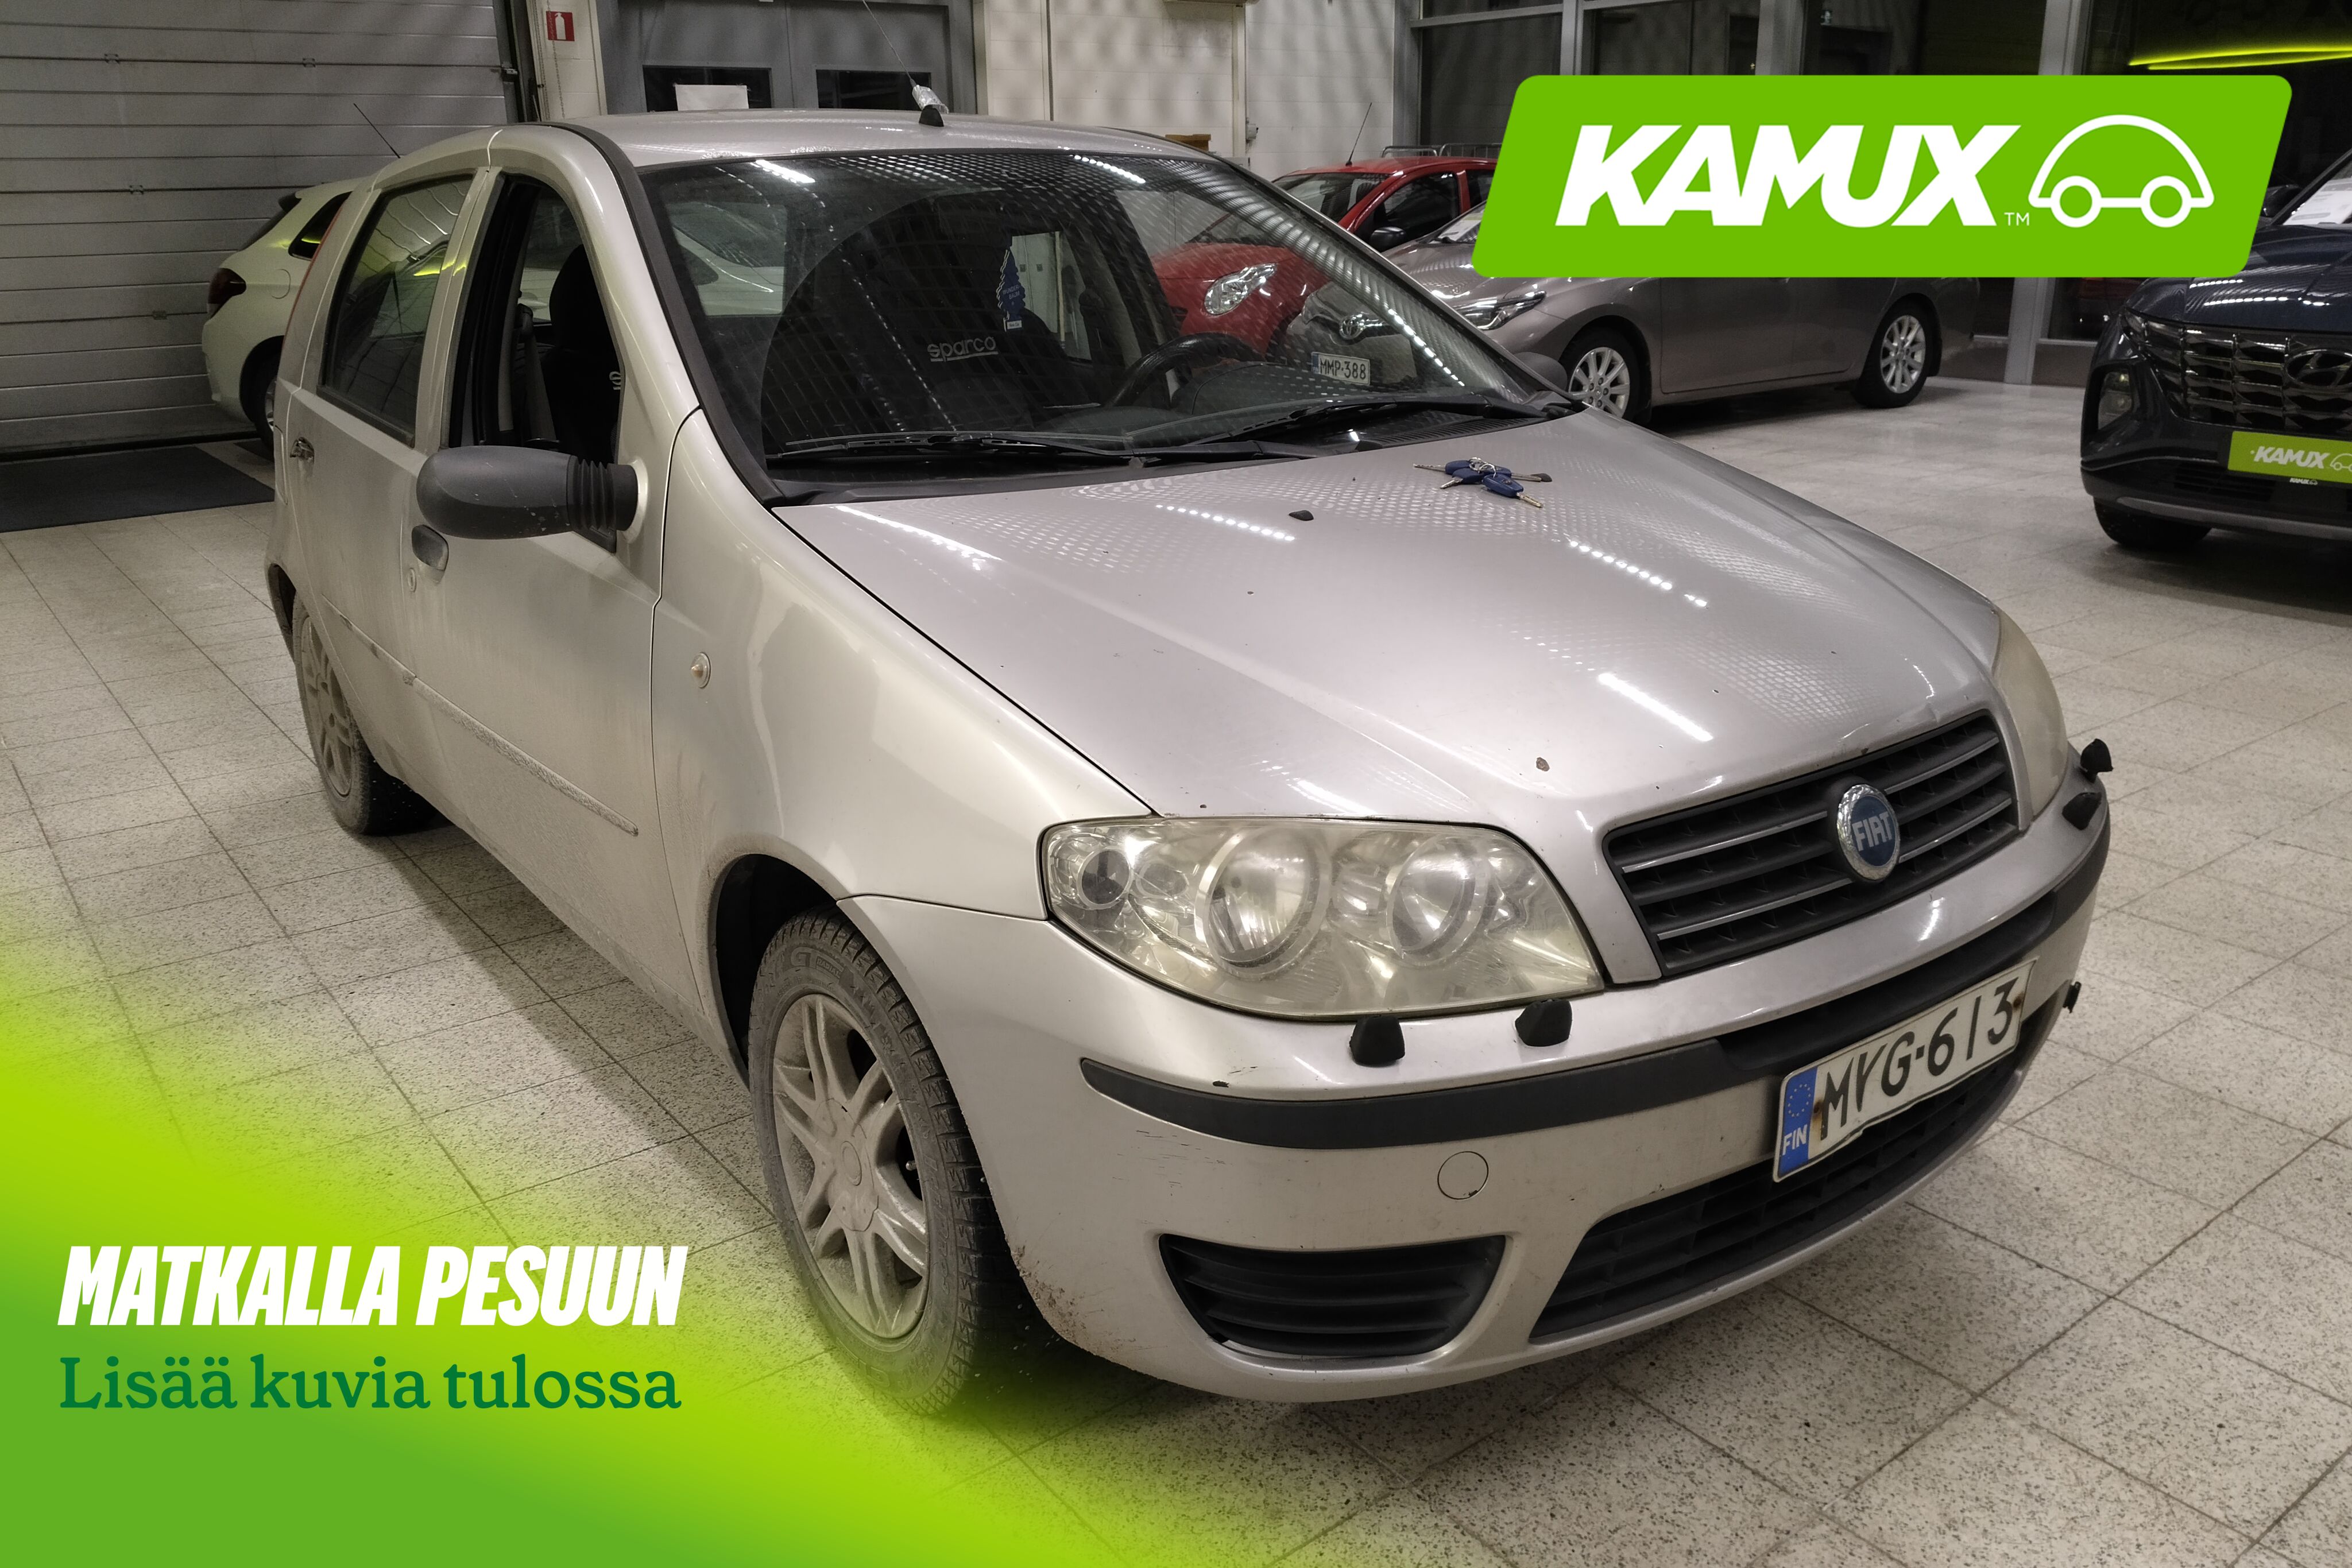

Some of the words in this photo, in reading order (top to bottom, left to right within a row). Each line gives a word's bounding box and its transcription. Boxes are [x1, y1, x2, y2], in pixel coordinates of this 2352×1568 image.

[927, 336, 996, 362] sparco
[1320, 358, 1367, 380] MMP-388
[2254, 446, 2330, 469] KAMUX
[1852, 811, 1893, 851] FIAT
[1782, 1124, 1808, 1155] FIN
